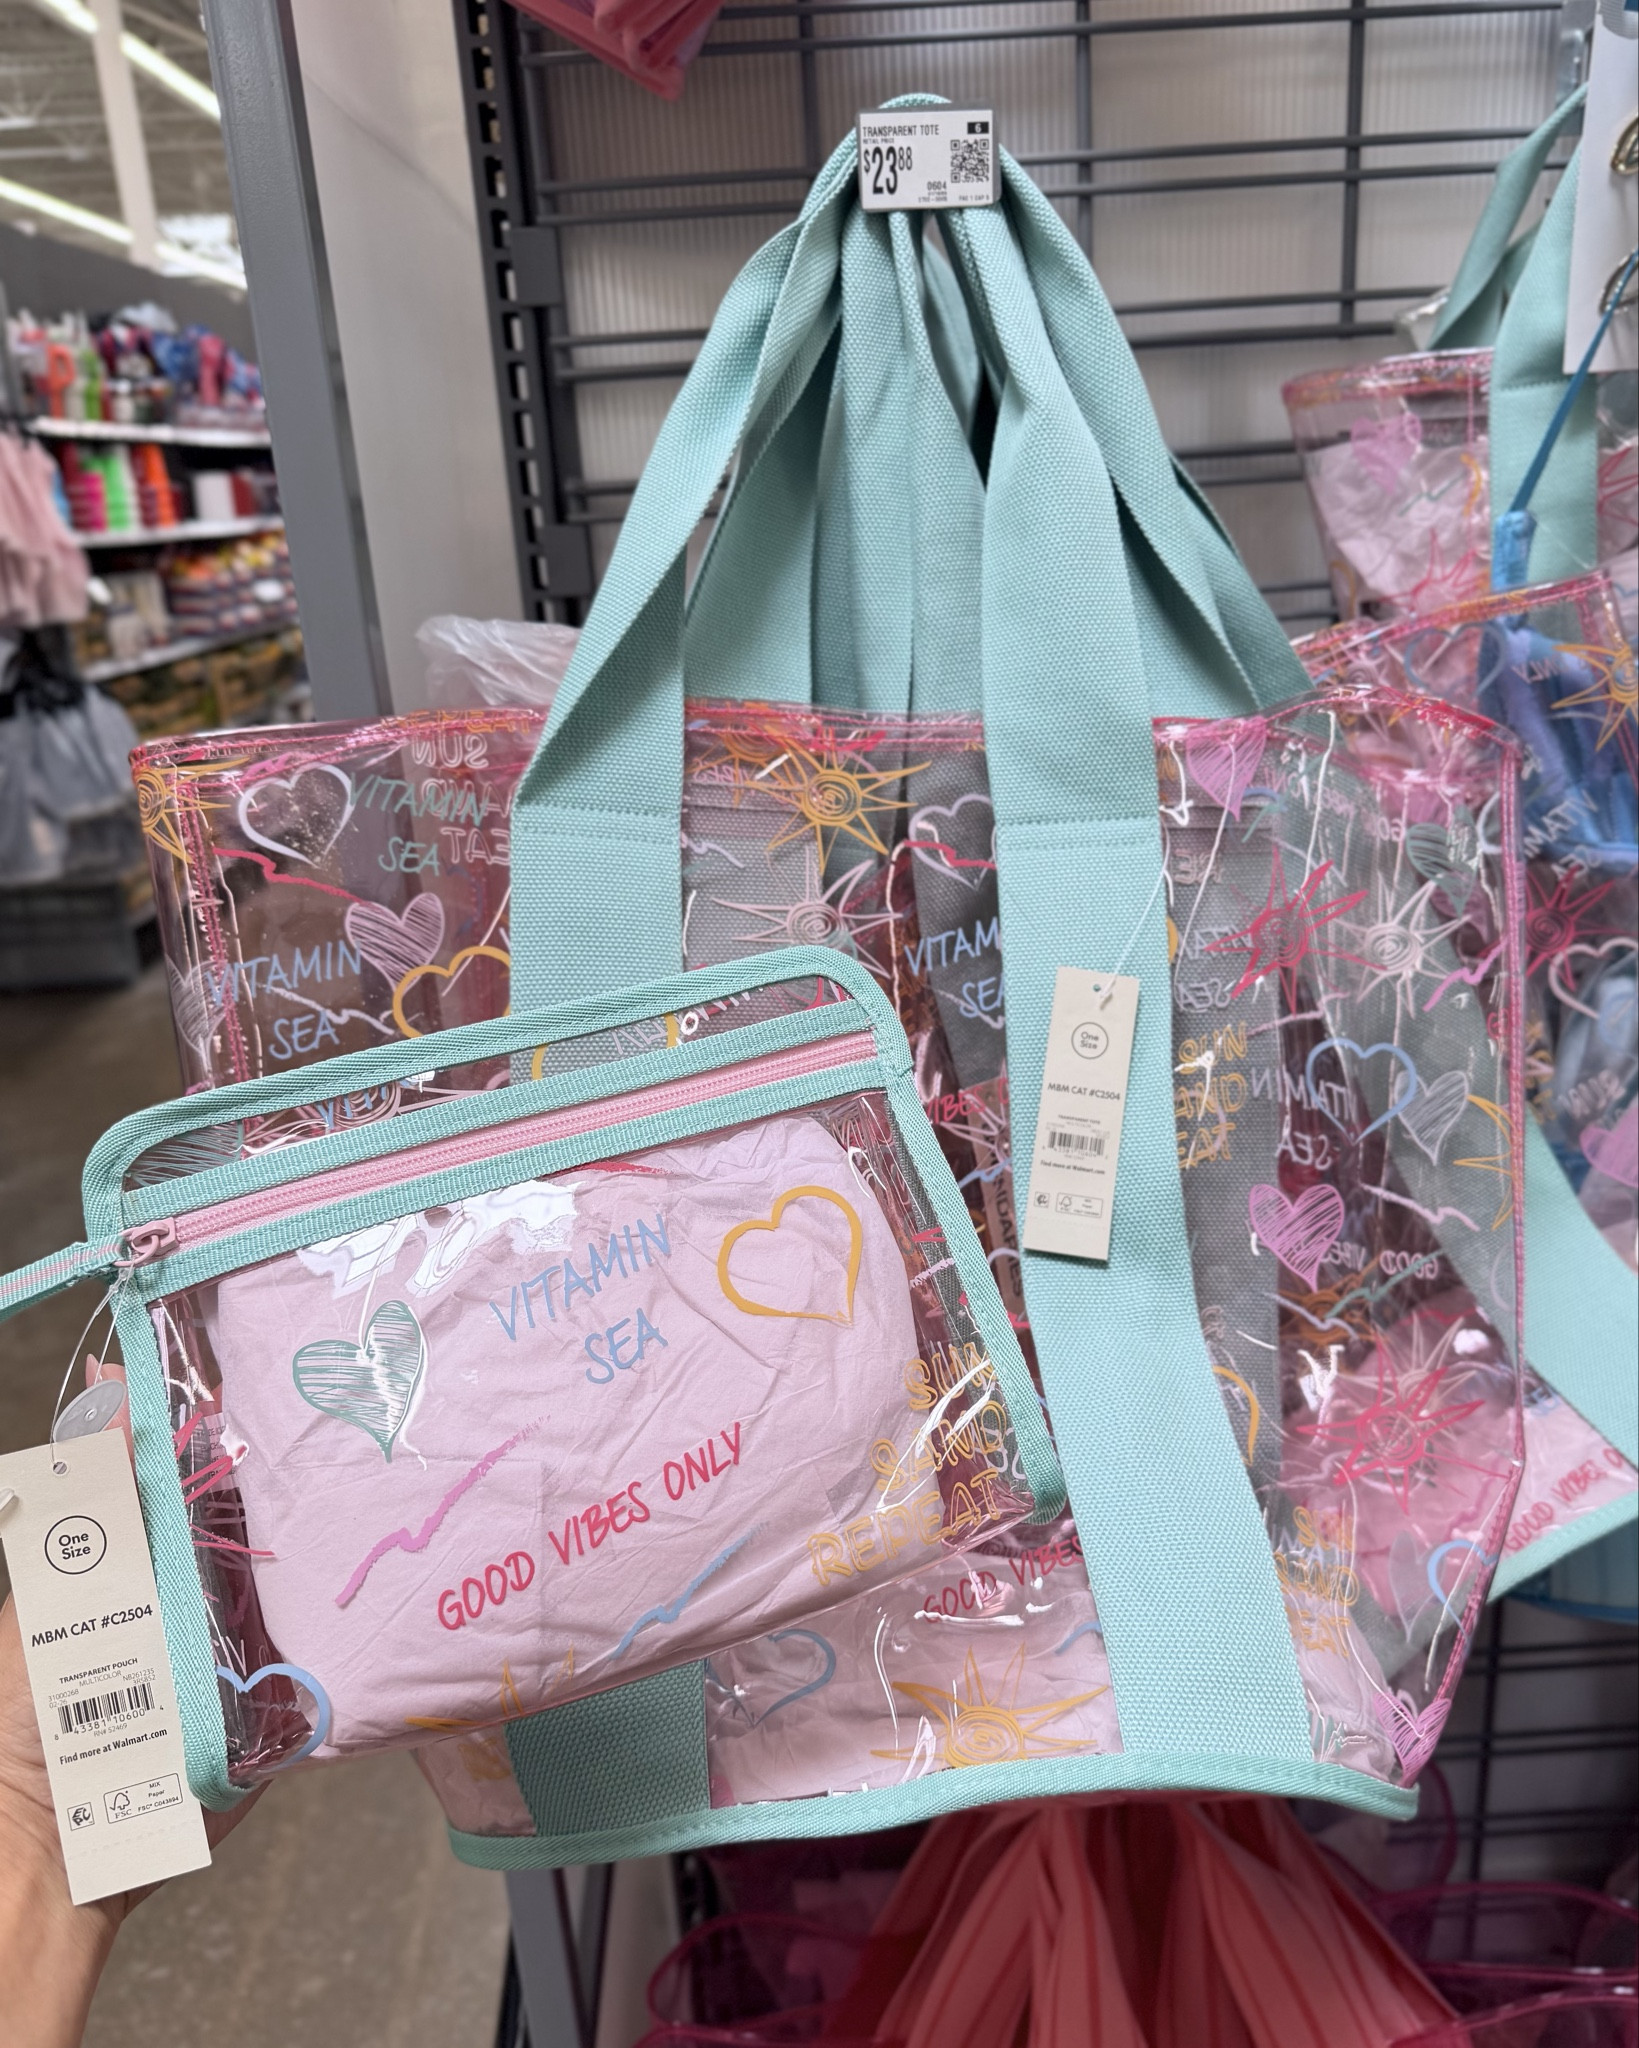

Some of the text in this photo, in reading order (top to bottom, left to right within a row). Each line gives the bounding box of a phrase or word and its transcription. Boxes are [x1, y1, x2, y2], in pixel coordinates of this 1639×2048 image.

[863, 124, 940, 137] TRANSPARENT TOTE
[350, 772, 489, 827] VITAMIN
[379, 836, 440, 874] SEA
[207, 942, 362, 1007] VITAMIN
[270, 1014, 340, 1061] SEA
[1080, 1031, 1099, 1042] One
[1080, 1039, 1098, 1050] Size
[1047, 1082, 1121, 1101] MBM CAT #C2504
[488, 1213, 671, 1341] VITAMIN
[584, 1308, 669, 1384] SEA
[904, 1342, 997, 1411] SUN
[871, 1401, 1008, 1491] SAND
[59, 1530, 90, 1547] One
[438, 1421, 742, 1630] GOOD VIBES ONLY
[807, 1467, 1001, 1587] REPEAT
[1504, 1500, 1554, 1552] GOOD
[61, 1542, 92, 1561] Size
[923, 1534, 1086, 1625] GOOD VIBES
[31, 1604, 154, 1648] MBM CAT #C2504
[59, 1658, 138, 1684] TRANSPARENT POUCH
[79, 1670, 122, 1687] MULTICOLOR
[60, 1728, 168, 1766] Find more at Walmart.com
[114, 1808, 133, 1820] FSC
